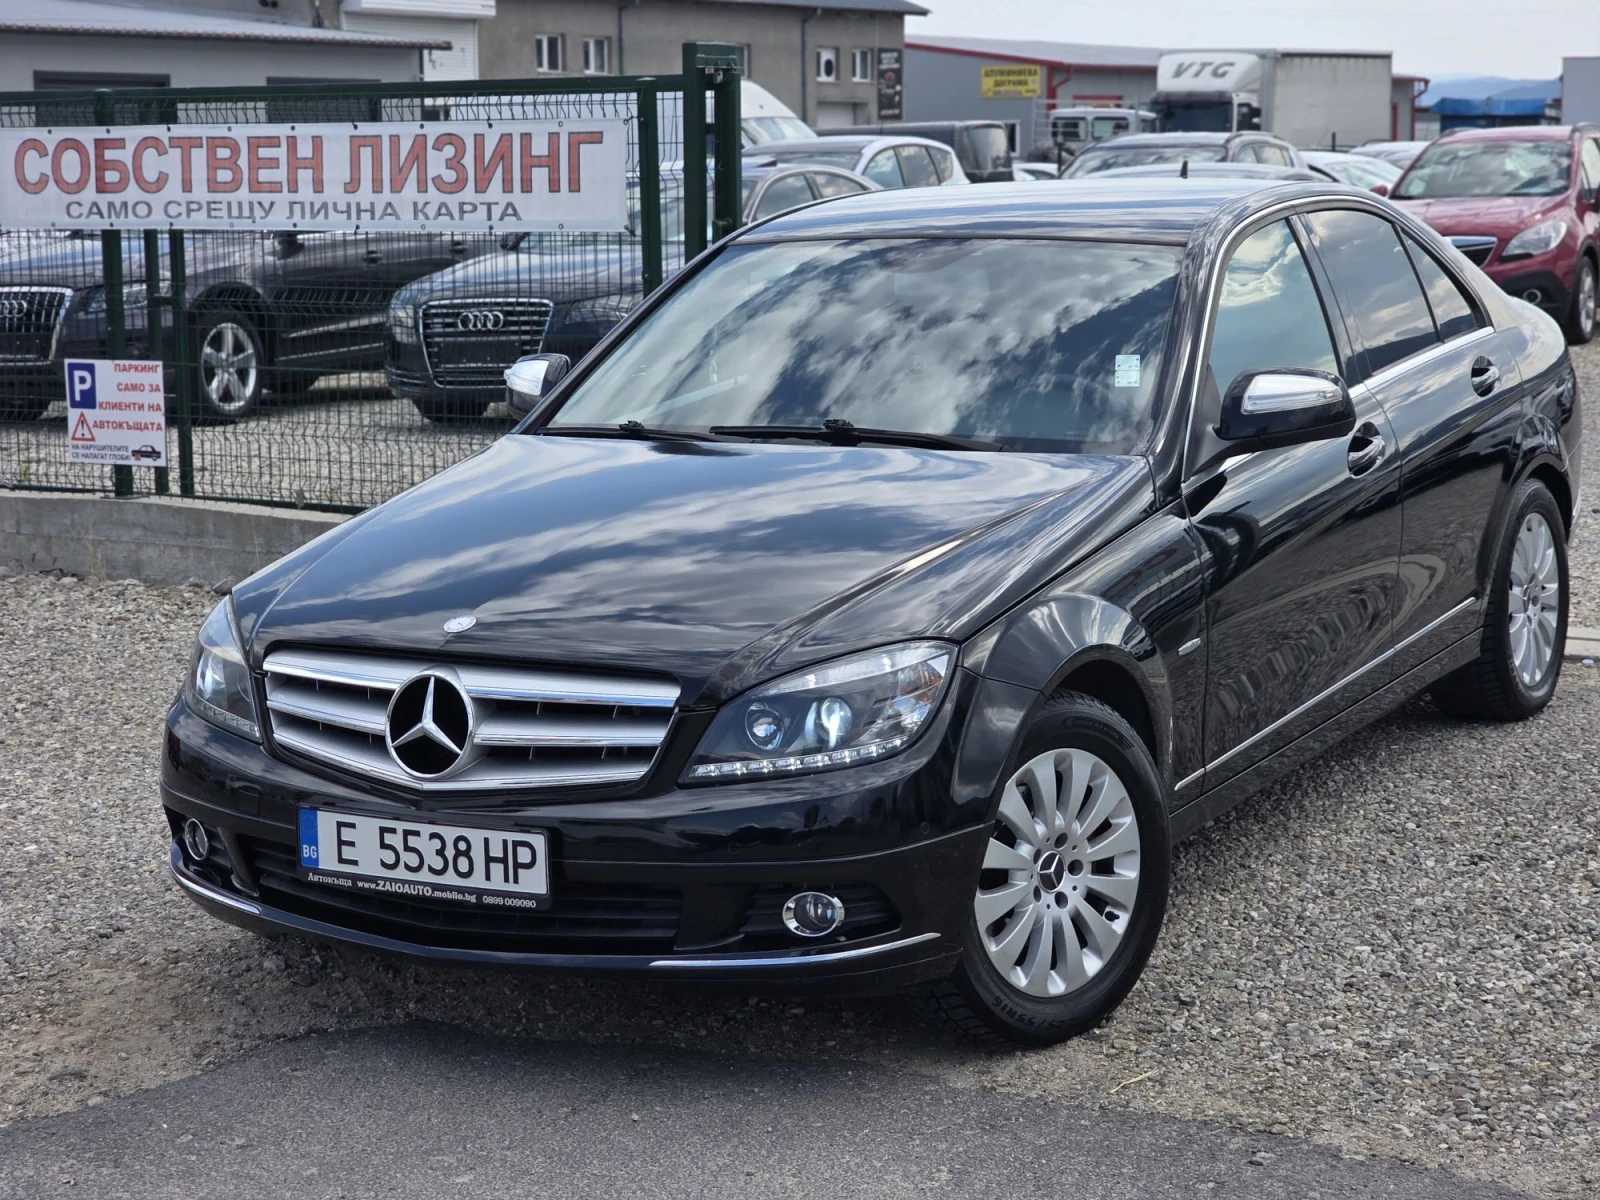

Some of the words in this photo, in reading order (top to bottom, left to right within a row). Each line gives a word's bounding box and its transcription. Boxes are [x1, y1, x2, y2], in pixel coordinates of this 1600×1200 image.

[1171, 61, 1236, 78] VTG
[13, 135, 324, 195] СОБСТВЕН
[343, 131, 604, 194] ЛИЗИНГ
[65, 201, 153, 220] САМО
[163, 201, 276, 223] СРЕЩУ
[285, 202, 401, 221] ЛИЧНА
[412, 202, 522, 222] КАРТА
[114, 363, 160, 373] ПАРКИНГ
[73, 370, 92, 402] P
[117, 383, 145, 392] САМО
[148, 384, 161, 393] ЗА
[98, 401, 144, 411] КЛИЕНТИ
[148, 403, 162, 412] НА
[92, 420, 163, 432] АВТОКЪЩАТА
[81, 444, 129, 452] НАРУШИТЕЛИТЕ
[303, 844, 317, 859] BG
[336, 821, 359, 866] E
[379, 826, 474, 879] 5538
[308, 872, 352, 887] Автокъща
[483, 895, 503, 905] 0899
[505, 898, 536, 908] 009090
